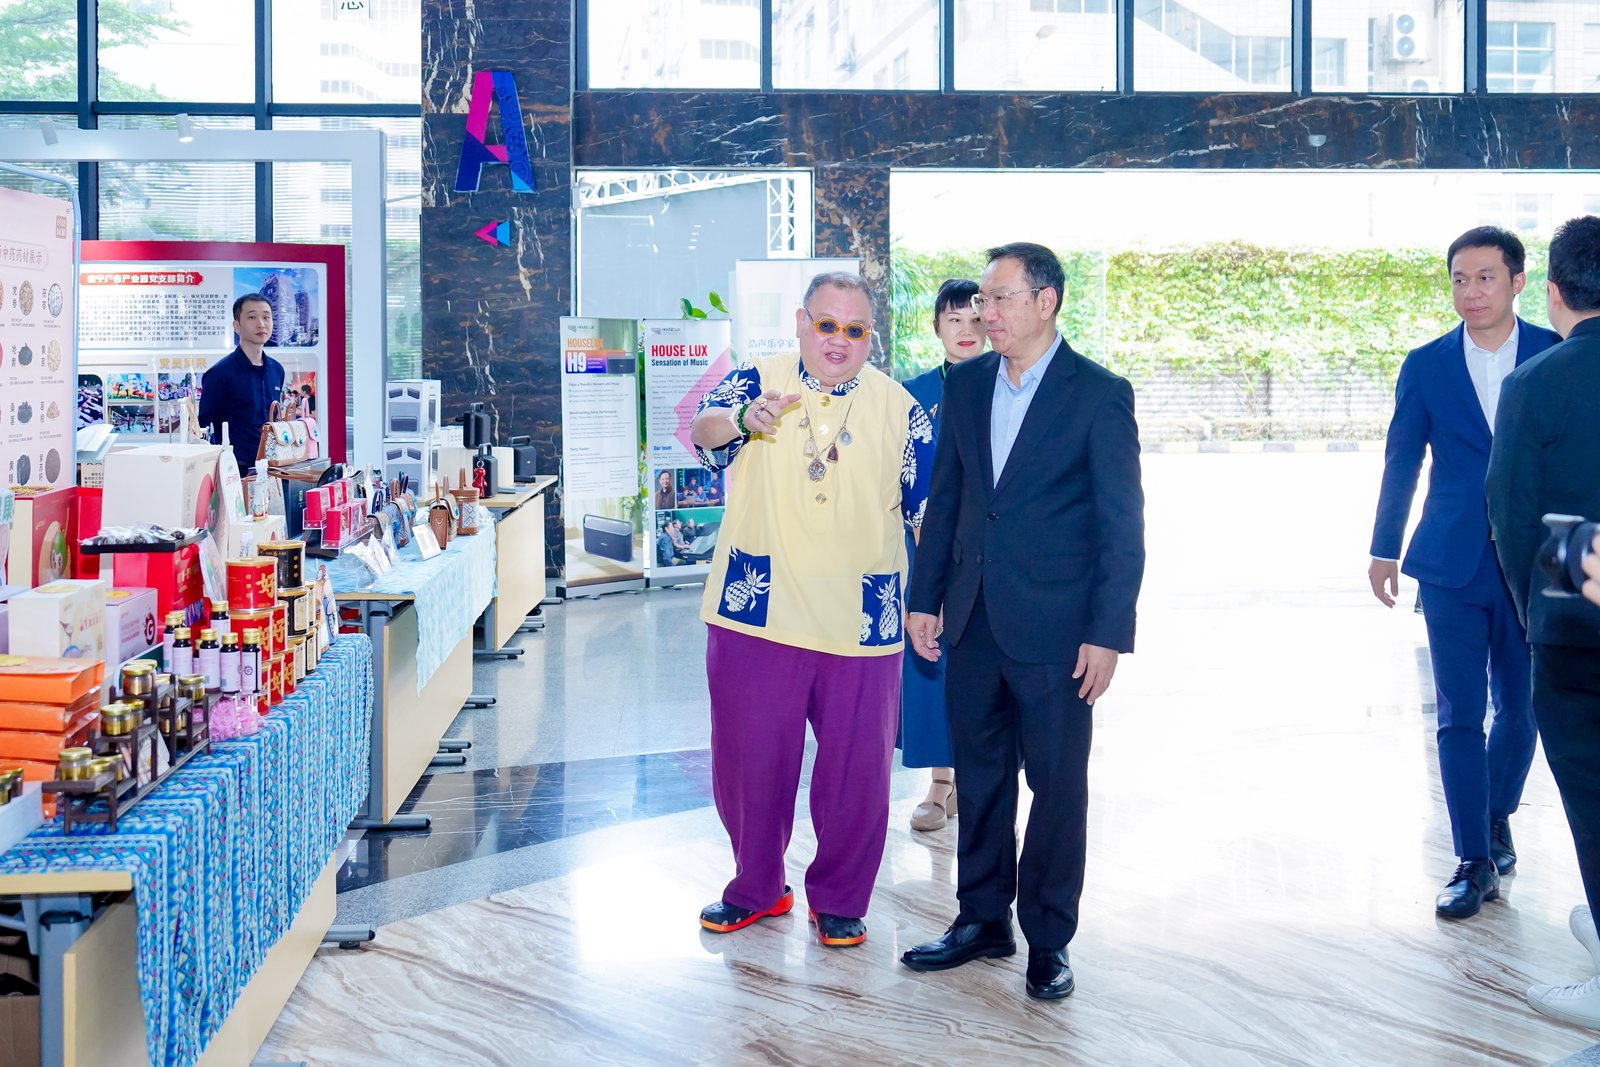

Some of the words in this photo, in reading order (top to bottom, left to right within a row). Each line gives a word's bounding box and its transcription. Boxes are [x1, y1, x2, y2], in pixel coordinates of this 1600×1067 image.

[454, 71, 537, 194] A
[651, 344, 686, 357] HOUSE
[689, 344, 708, 357] LUX
[567, 351, 586, 372] H9
[651, 359, 682, 367] Sensation
[683, 358, 689, 366] of
[690, 358, 708, 367] Music
[0, 494, 14, 521] 康
